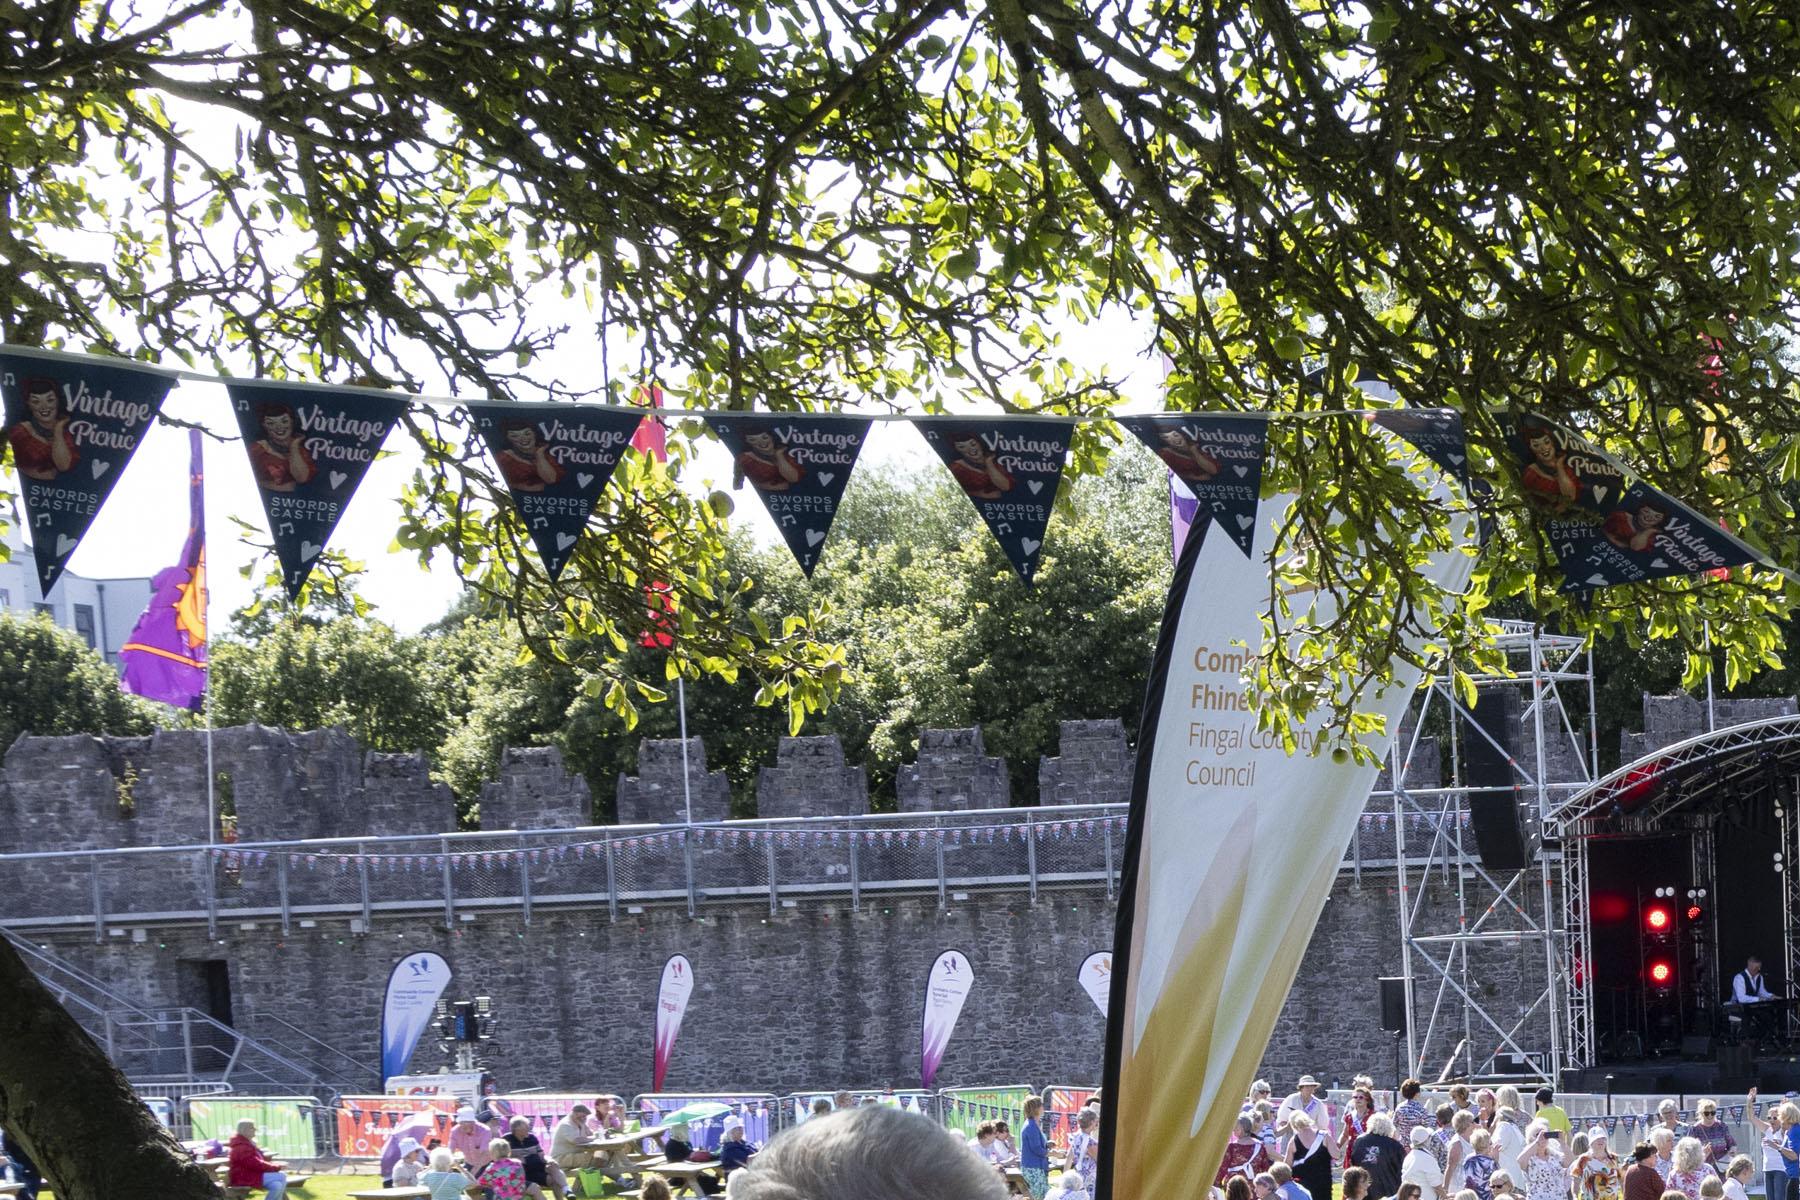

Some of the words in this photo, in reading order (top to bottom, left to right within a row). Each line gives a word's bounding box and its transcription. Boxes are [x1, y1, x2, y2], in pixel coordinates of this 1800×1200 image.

[63, 380, 151, 427] Vintage
[297, 404, 385, 442] Vintage
[69, 420, 136, 450] Picnic
[538, 419, 626, 448] Vintage
[774, 425, 860, 450] Vintage
[980, 430, 1063, 457] Vintage
[1181, 423, 1261, 447] Vintage
[304, 438, 371, 462] Picnic
[550, 445, 615, 465] Picnic
[788, 447, 852, 465] Picnic
[1201, 444, 1260, 460] Picnic
[997, 455, 1059, 473] Picnic
[1567, 455, 1620, 477] Picnic
[31, 485, 98, 503] SWORDS
[1195, 484, 1253, 493] SWORDS
[1200, 491, 1254, 501] CASTLE
[29, 497, 96, 515] CASTLE
[271, 497, 338, 512] SWORDS
[523, 496, 589, 507] SWORDS
[769, 495, 833, 504] SWORDS
[770, 504, 833, 513] CASTLE
[984, 503, 1044, 513] SWORDS
[271, 507, 337, 522] CASTLE
[524, 505, 588, 516] CASTLE
[986, 512, 1046, 522] CASTLE
[1552, 529, 1596, 540] CASTL
[1664, 517, 1725, 566] Vintage
[1592, 545, 1637, 580] CASTLE
[1599, 542, 1645, 577] SWORDS
[1654, 535, 1700, 572] Picnic
[1191, 684, 1250, 711] Fhine
[1189, 722, 1246, 755] Fingal
[1186, 760, 1257, 787] Council
